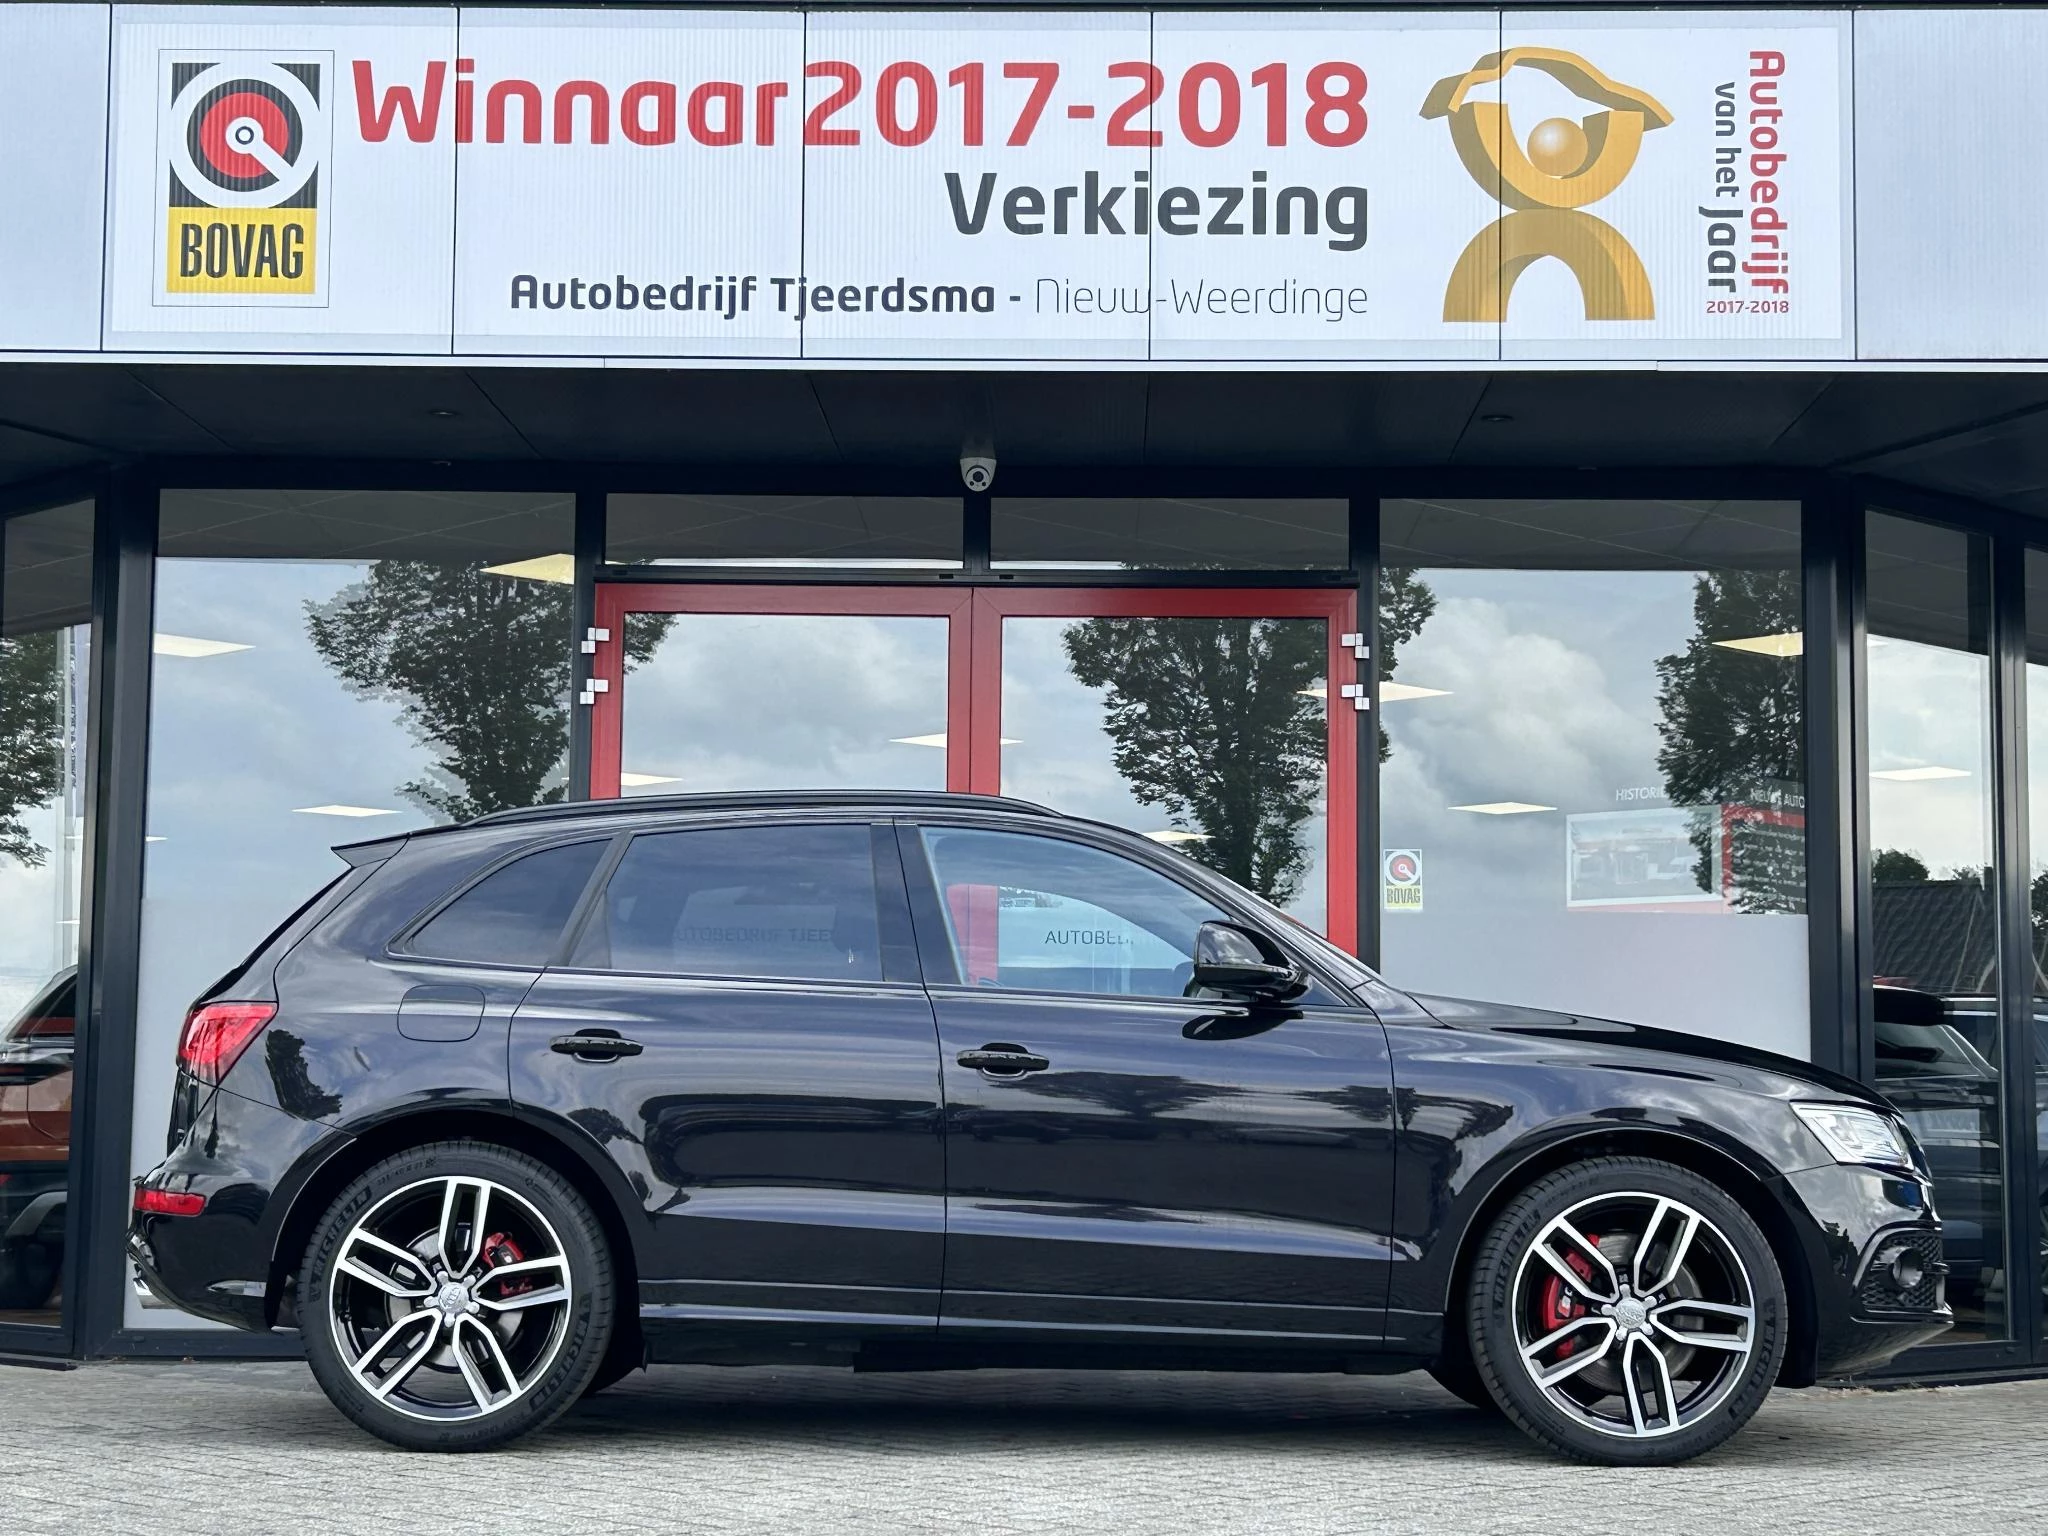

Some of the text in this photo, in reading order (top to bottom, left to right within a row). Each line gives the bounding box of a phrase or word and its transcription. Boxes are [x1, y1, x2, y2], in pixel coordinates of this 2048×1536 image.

[353, 59, 1368, 147] Winnaar 2017-2018
[944, 171, 1368, 251] Verkiezing
[1699, 82, 1742, 293] van het Jaar
[1742, 51, 1789, 294] Autobedrijf
[180, 223, 304, 279] BOVAG
[511, 275, 757, 320] Autobedrijf
[770, 277, 995, 321] Tjeerdsma
[1036, 278, 1368, 322] Nieuw-Weerdinge
[1706, 301, 1789, 314] 2017-2018
[1387, 888, 1420, 903] BOVAG
[313, 1185, 373, 1276] MICHELIN
[1491, 1213, 1541, 1301] MICHELIN
[526, 1318, 589, 1409] MICHELIN
[1728, 1324, 1776, 1415] MICHELIN
